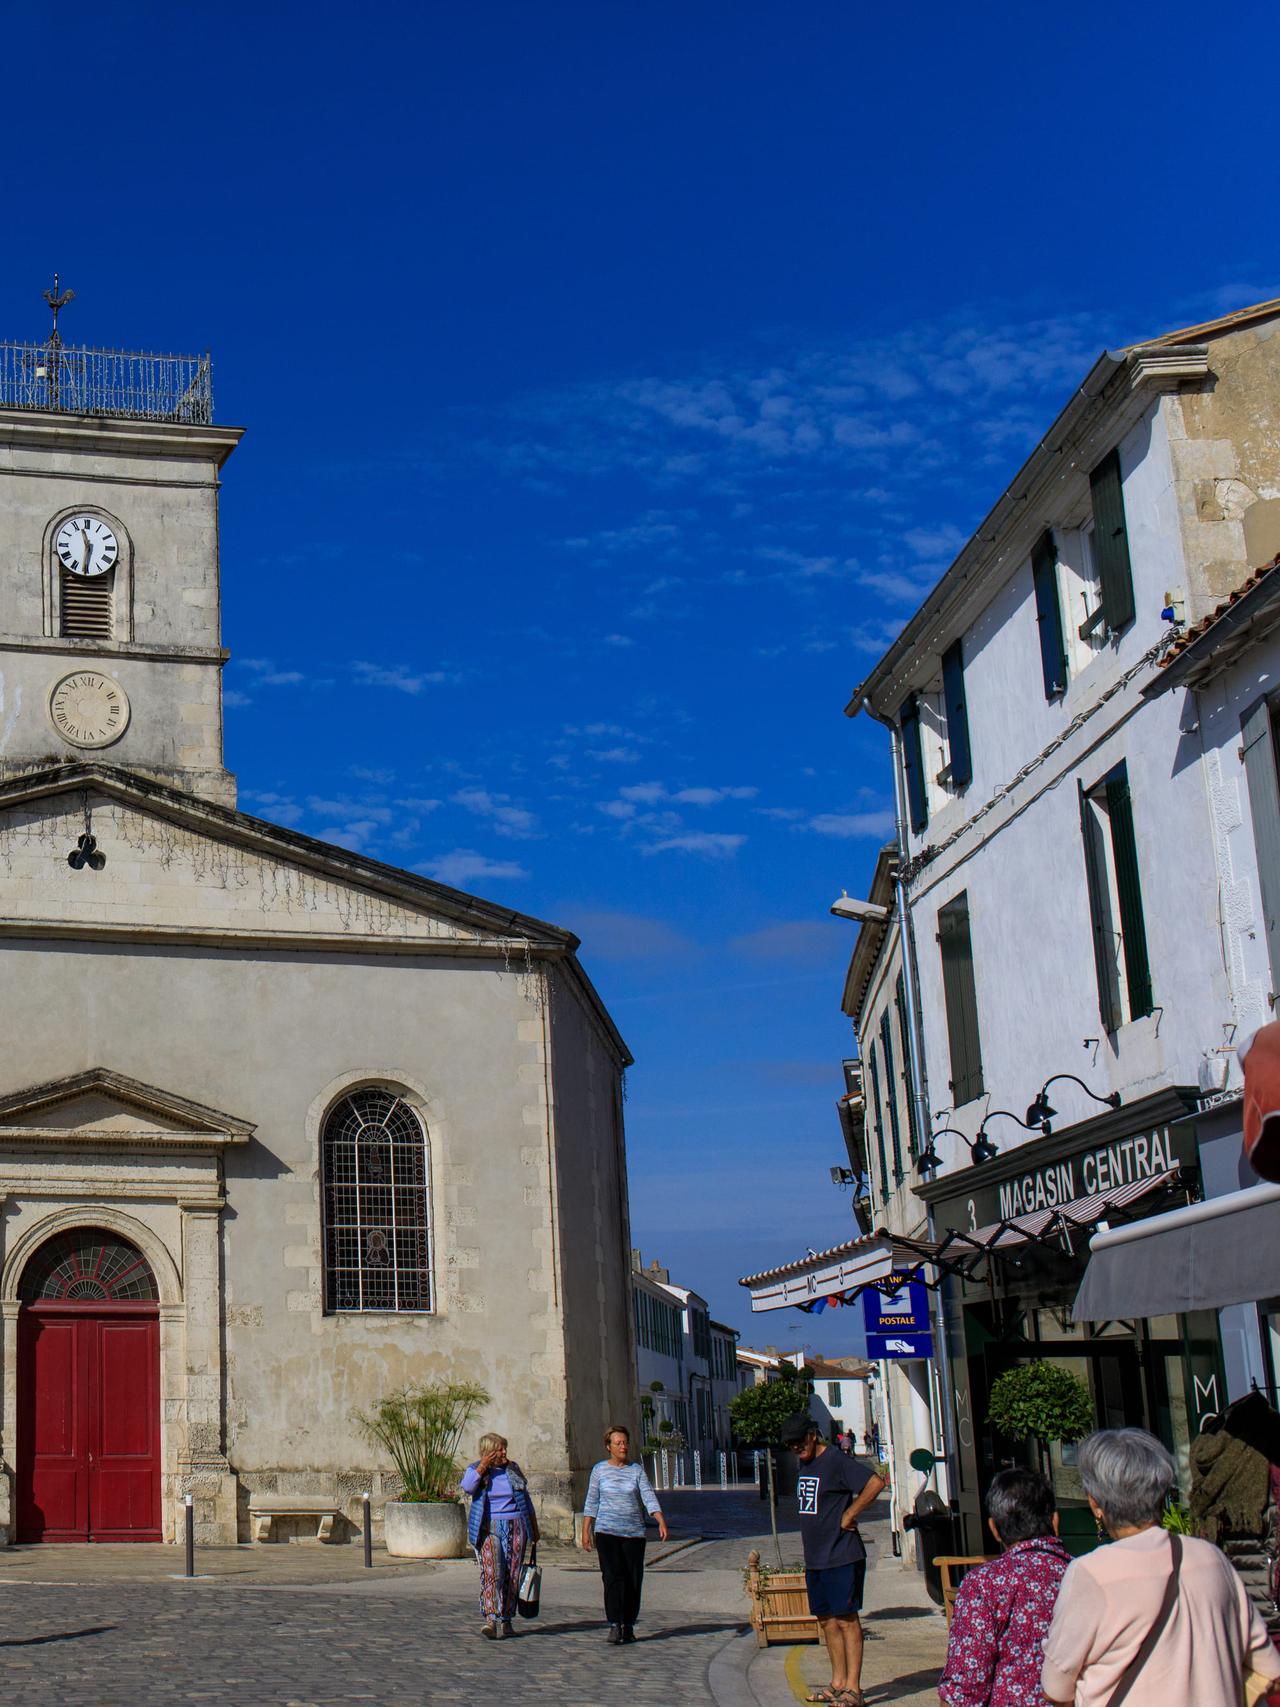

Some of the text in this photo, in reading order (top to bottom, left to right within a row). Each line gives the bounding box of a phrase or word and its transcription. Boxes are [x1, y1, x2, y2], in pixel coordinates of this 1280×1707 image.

[967, 1127, 1180, 1232] 3 MAGASIN CENTRAL
[806, 1275, 817, 1295] MC
[839, 1266, 845, 1286] 3
[879, 1316, 916, 1325] POSTALE
